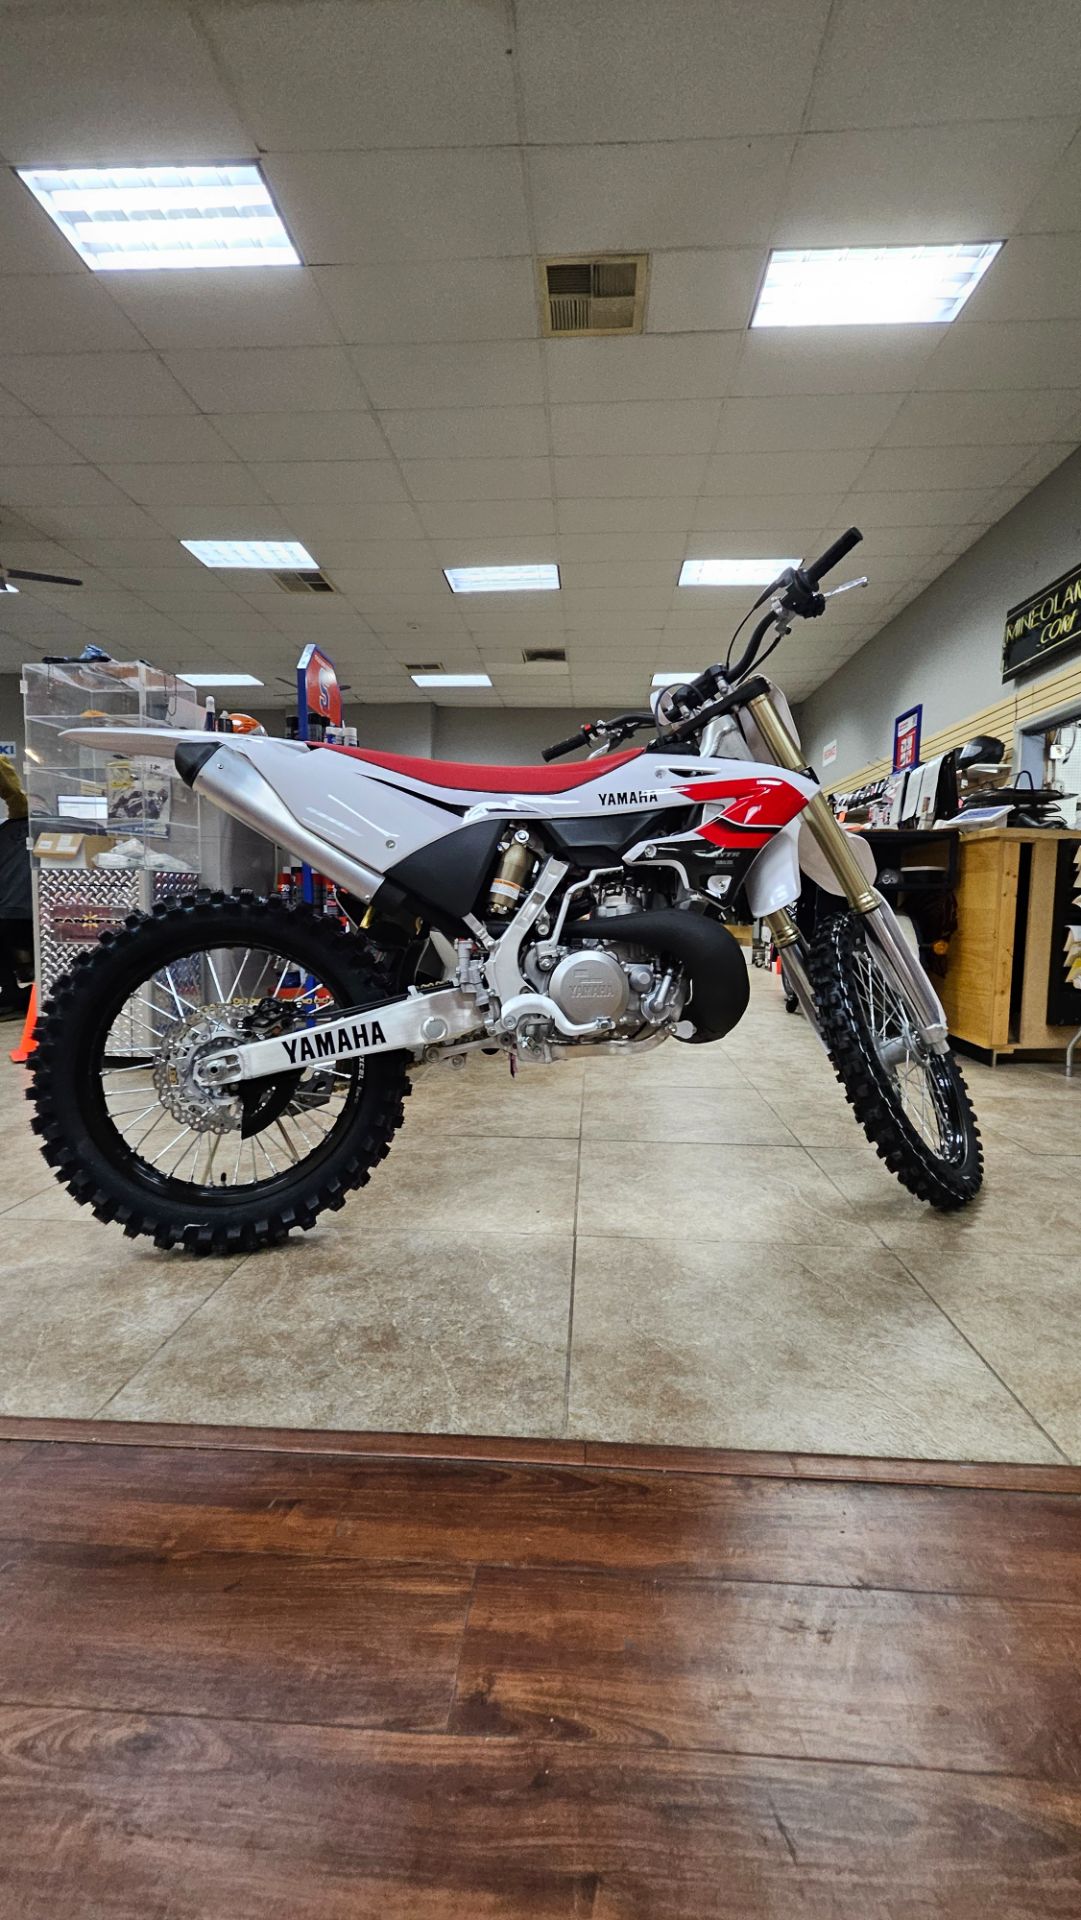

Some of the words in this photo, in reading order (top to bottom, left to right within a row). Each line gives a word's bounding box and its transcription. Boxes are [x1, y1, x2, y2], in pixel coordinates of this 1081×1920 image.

[598, 791, 658, 806] YAMAHA
[568, 984, 615, 999] YAMAHA
[281, 1021, 387, 1064] YAMAHA
[358, 1054, 366, 1081] XCEL
